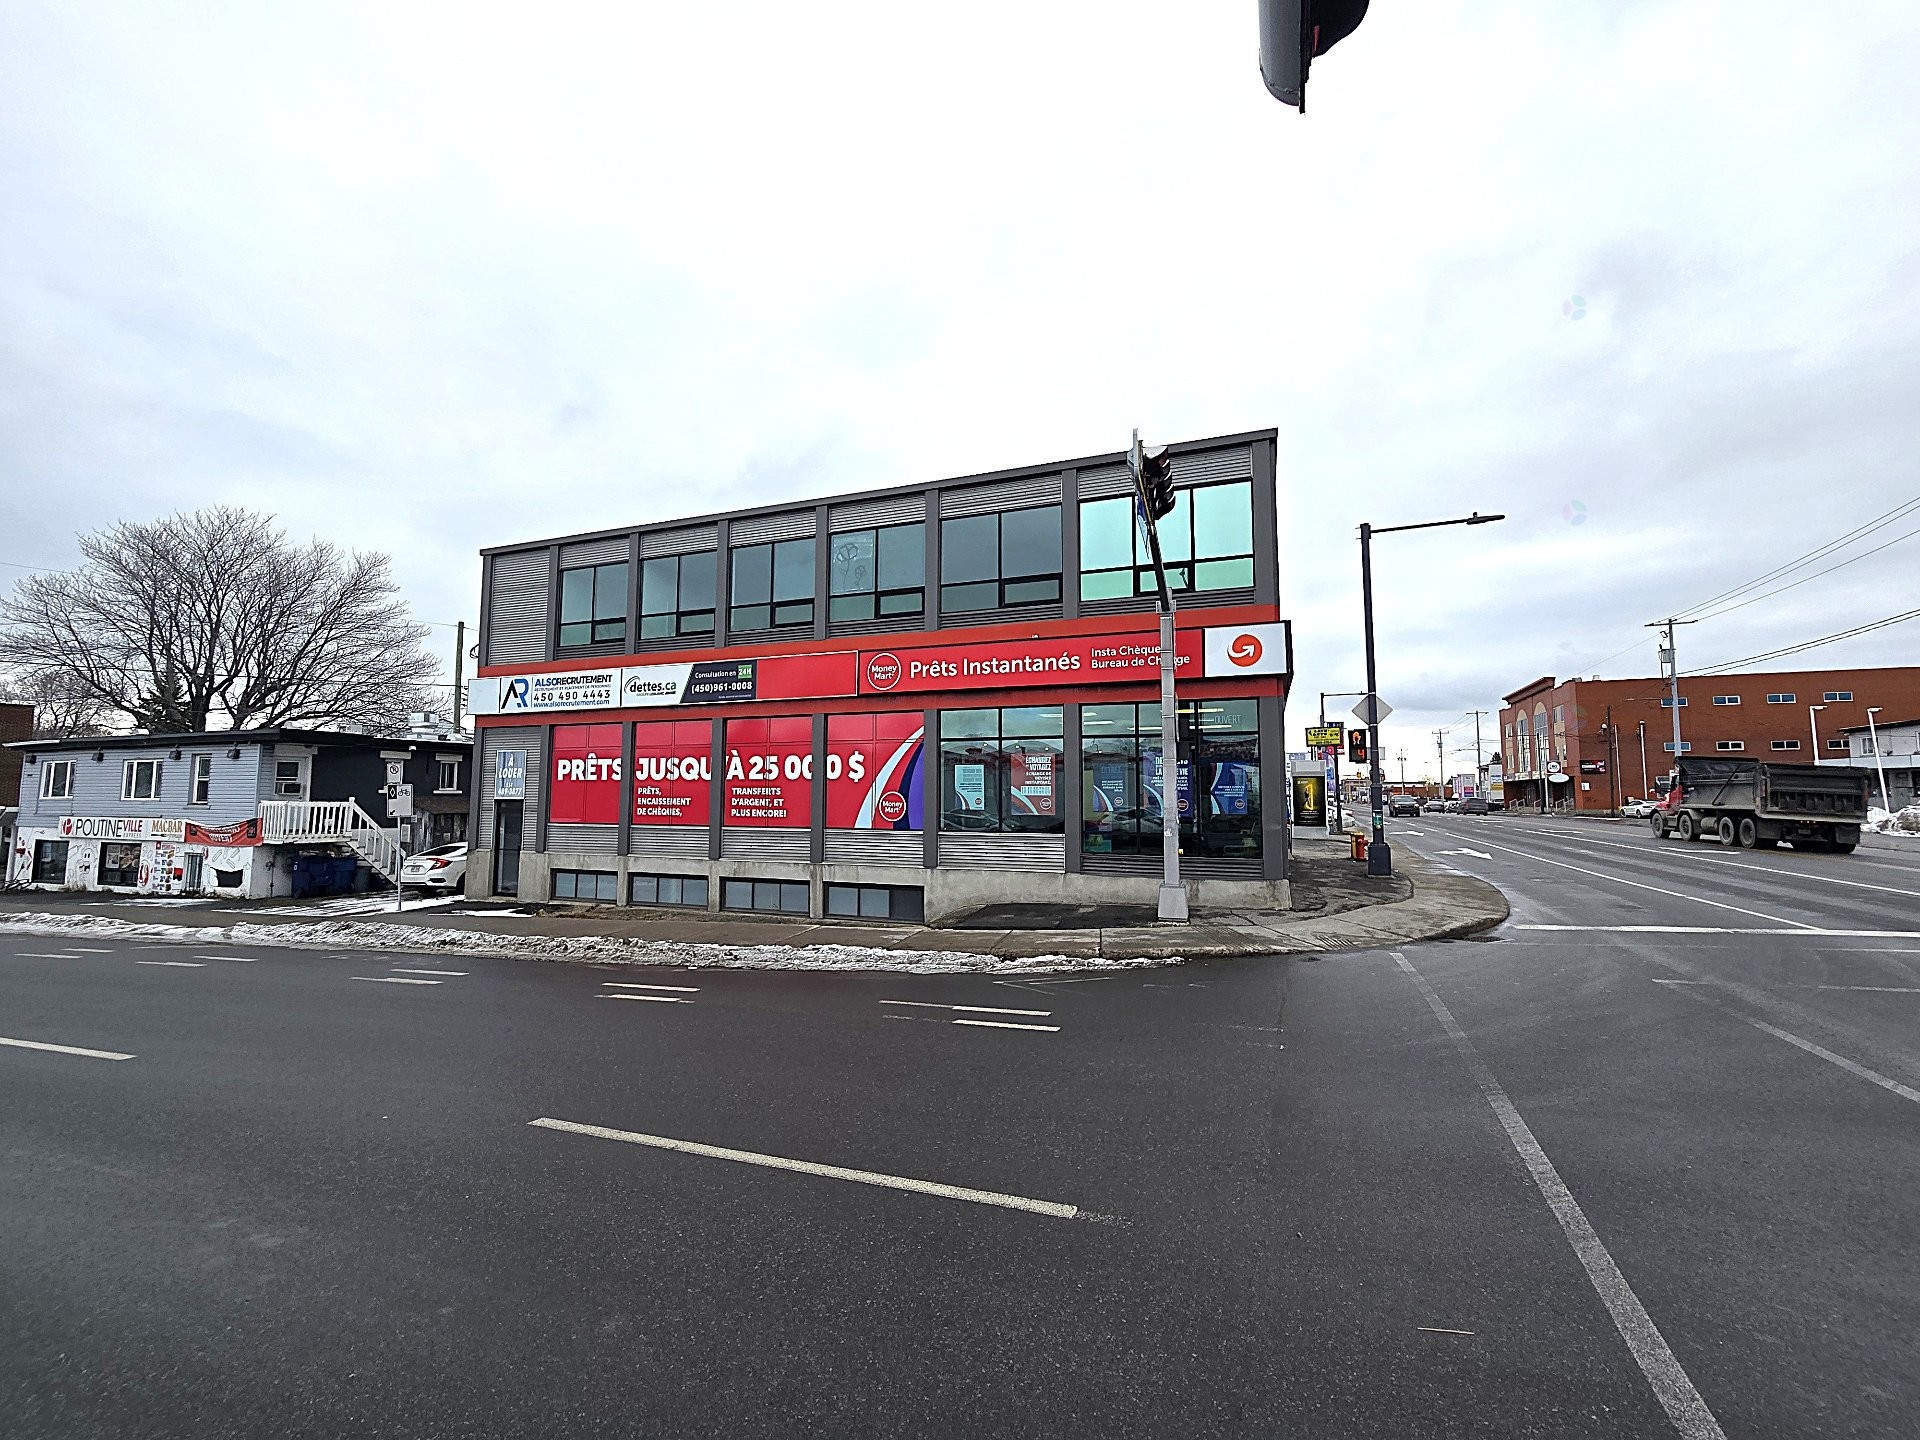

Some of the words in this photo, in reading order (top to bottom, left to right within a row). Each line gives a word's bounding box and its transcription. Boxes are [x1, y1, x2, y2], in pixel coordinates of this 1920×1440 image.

[1091, 647, 1117, 658] Insta
[909, 660, 958, 679] Prêts
[962, 651, 1081, 676] Instantanés
[1091, 658, 1129, 669] Bureau
[1131, 657, 1145, 666] de
[1147, 655, 1191, 668] Chge
[738, 666, 752, 675] 24H
[871, 664, 897, 674] Money
[534, 674, 613, 687] ALSORECRUTEMENT
[694, 671, 728, 679] Consultation
[873, 672, 894, 681] Mart
[629, 681, 677, 693] dettes.ca
[691, 681, 753, 695] (450)961-0008
[533, 692, 553, 702] 450
[558, 691, 578, 701] 490
[582, 689, 611, 700] 4443
[533, 699, 610, 708] www.alsorecrutement.com
[1214, 714, 1242, 725] OUVERT
[557, 752, 622, 781] PRÊTS
[748, 755, 780, 780] 25
[847, 751, 866, 783] $
[498, 767, 523, 779] LOUER
[637, 785, 662, 796] PRÊTS,
[731, 787, 781, 796] TRANSFERTS
[637, 797, 692, 806] ENCAISSEMENT
[731, 798, 772, 807] D'ARGENT,
[773, 798, 785, 807] ET
[882, 800, 904, 809] Money
[636, 807, 646, 816] DE
[647, 805, 683, 817] CHÈQUES,
[731, 808, 750, 817] PLUS
[751, 808, 787, 818] ENCORE!
